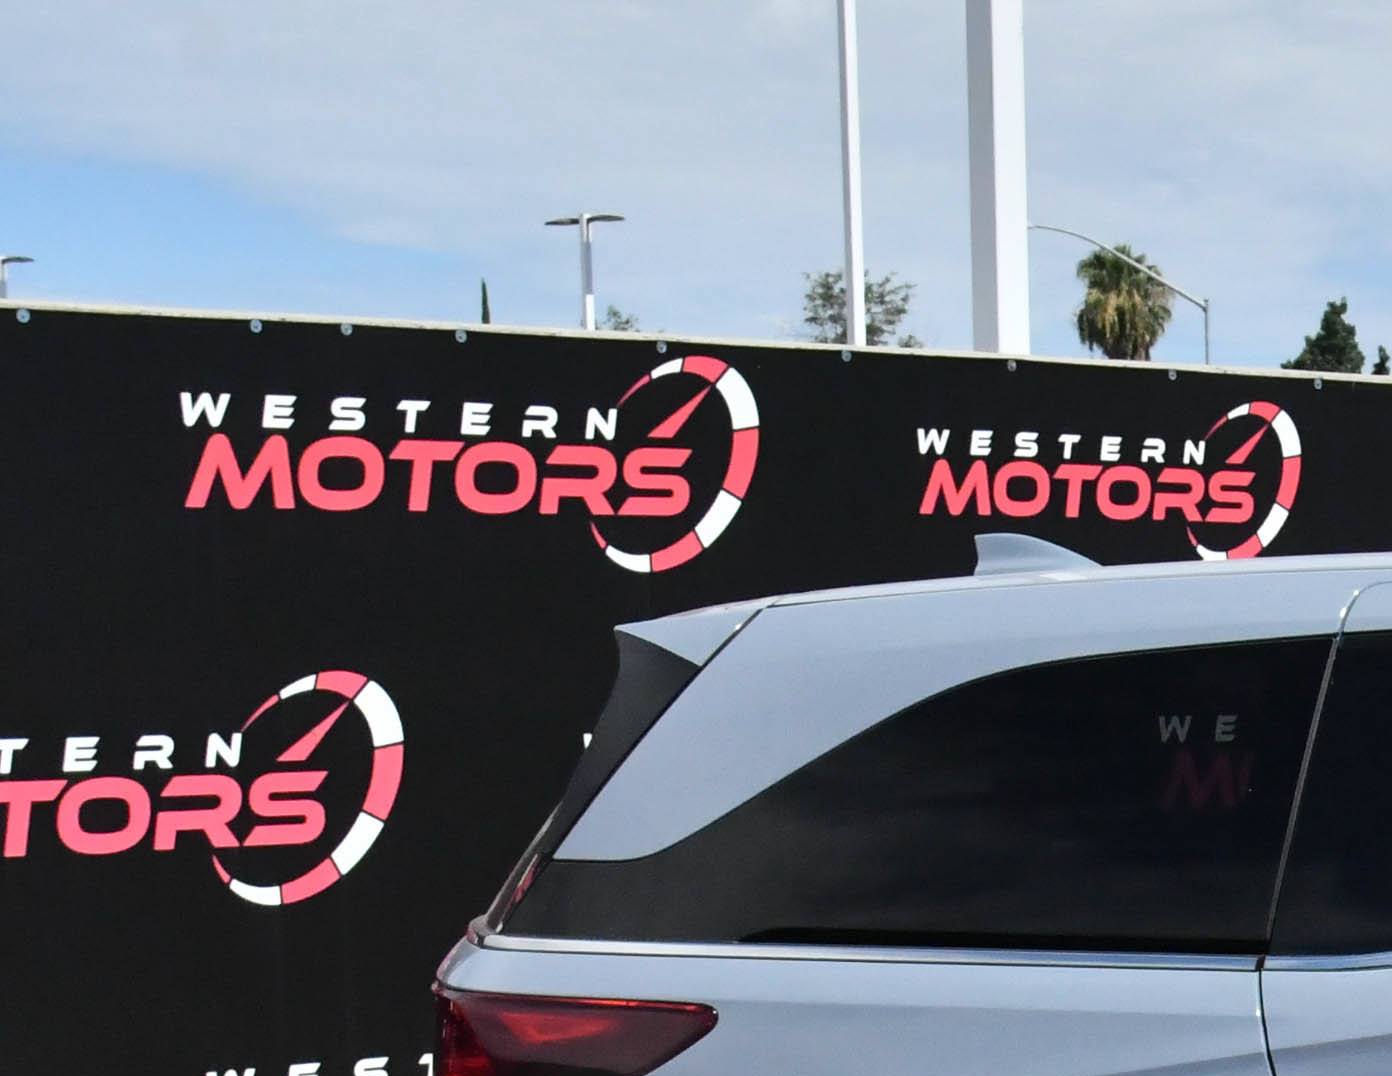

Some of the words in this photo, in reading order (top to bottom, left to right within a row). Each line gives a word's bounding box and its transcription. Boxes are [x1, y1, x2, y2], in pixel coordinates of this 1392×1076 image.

[179, 391, 618, 441] WESTERN
[916, 427, 1206, 466] WESTERN
[184, 432, 693, 517] MOTORS
[919, 458, 1257, 524] MOTORS
[0, 770, 329, 858] TORS
